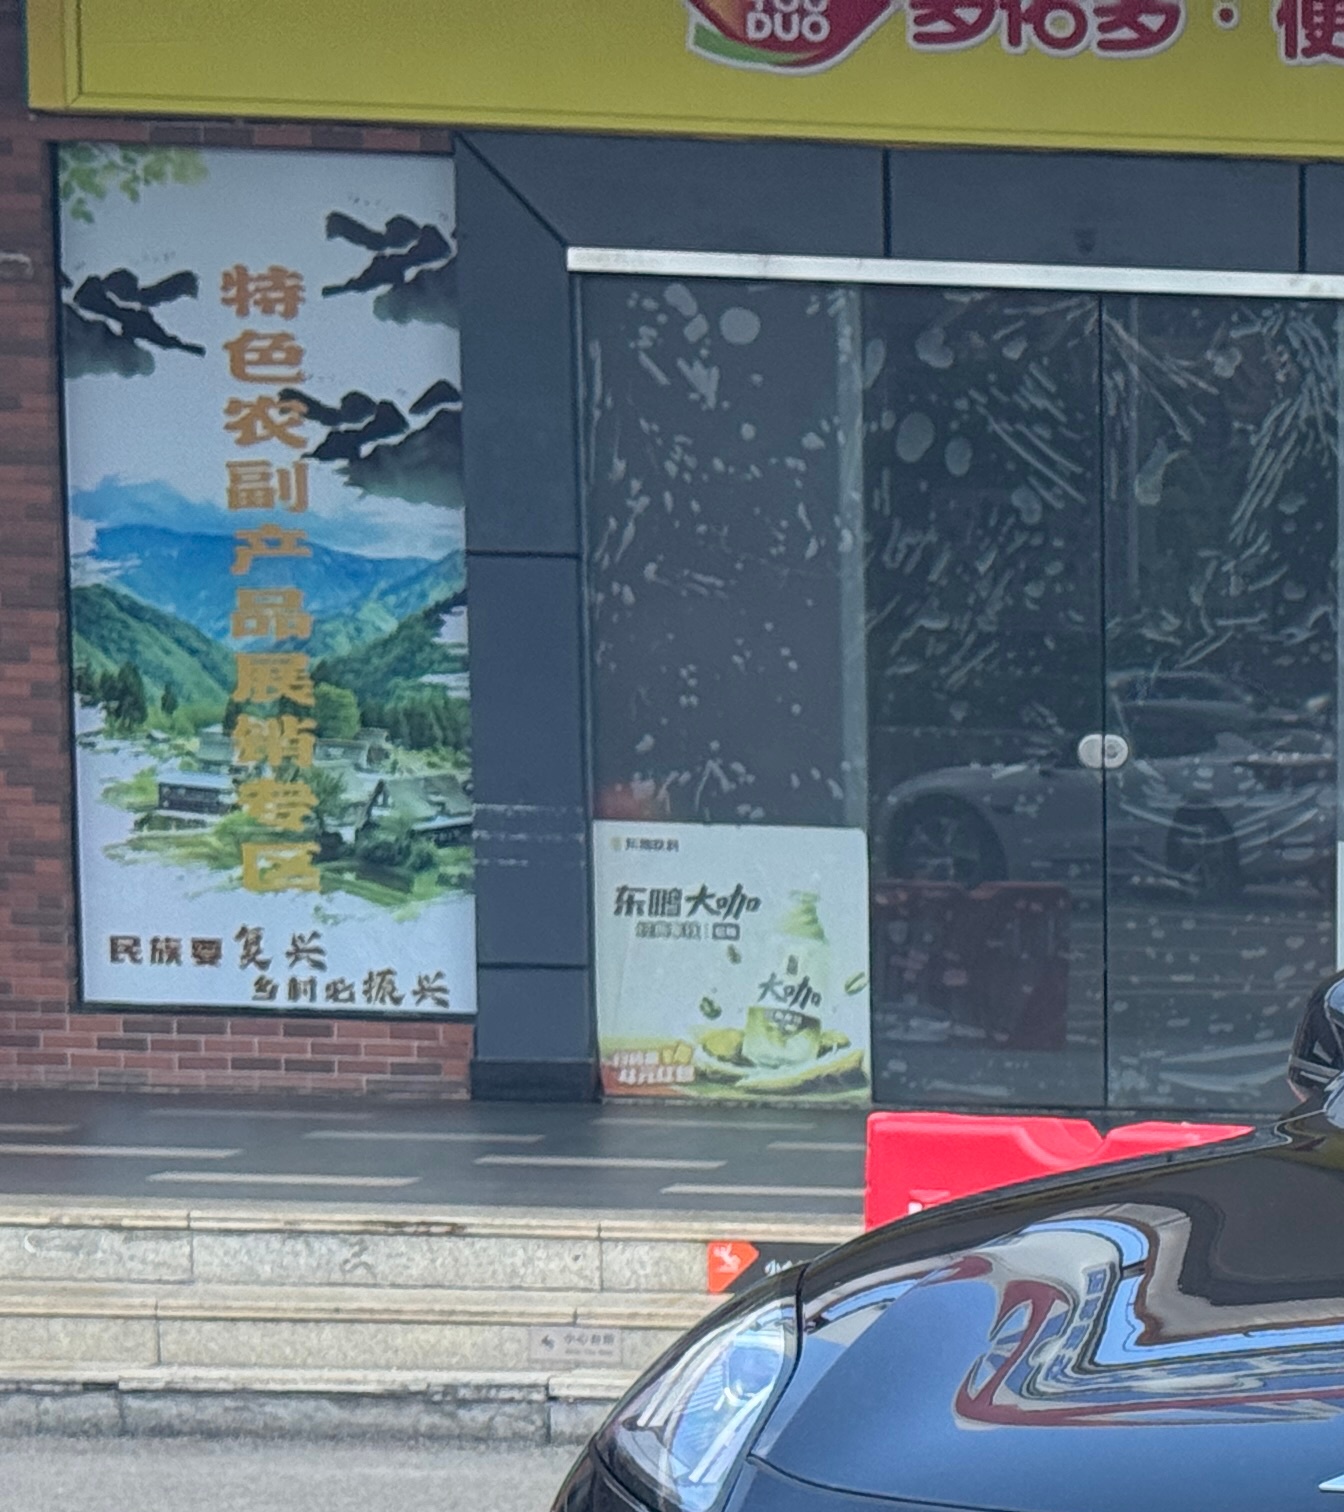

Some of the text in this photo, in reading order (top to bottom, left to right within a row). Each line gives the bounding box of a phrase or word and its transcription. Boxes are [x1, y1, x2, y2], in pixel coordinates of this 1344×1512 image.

[746, 14, 831, 41] DUO
[221, 264, 320, 895] 特色农副产品展销专区
[613, 883, 761, 920] 东鹏大咖
[109, 924, 327, 971] 民族要复兴
[252, 967, 450, 1008] 乡村必振兴
[758, 972, 822, 1010] 大咖
